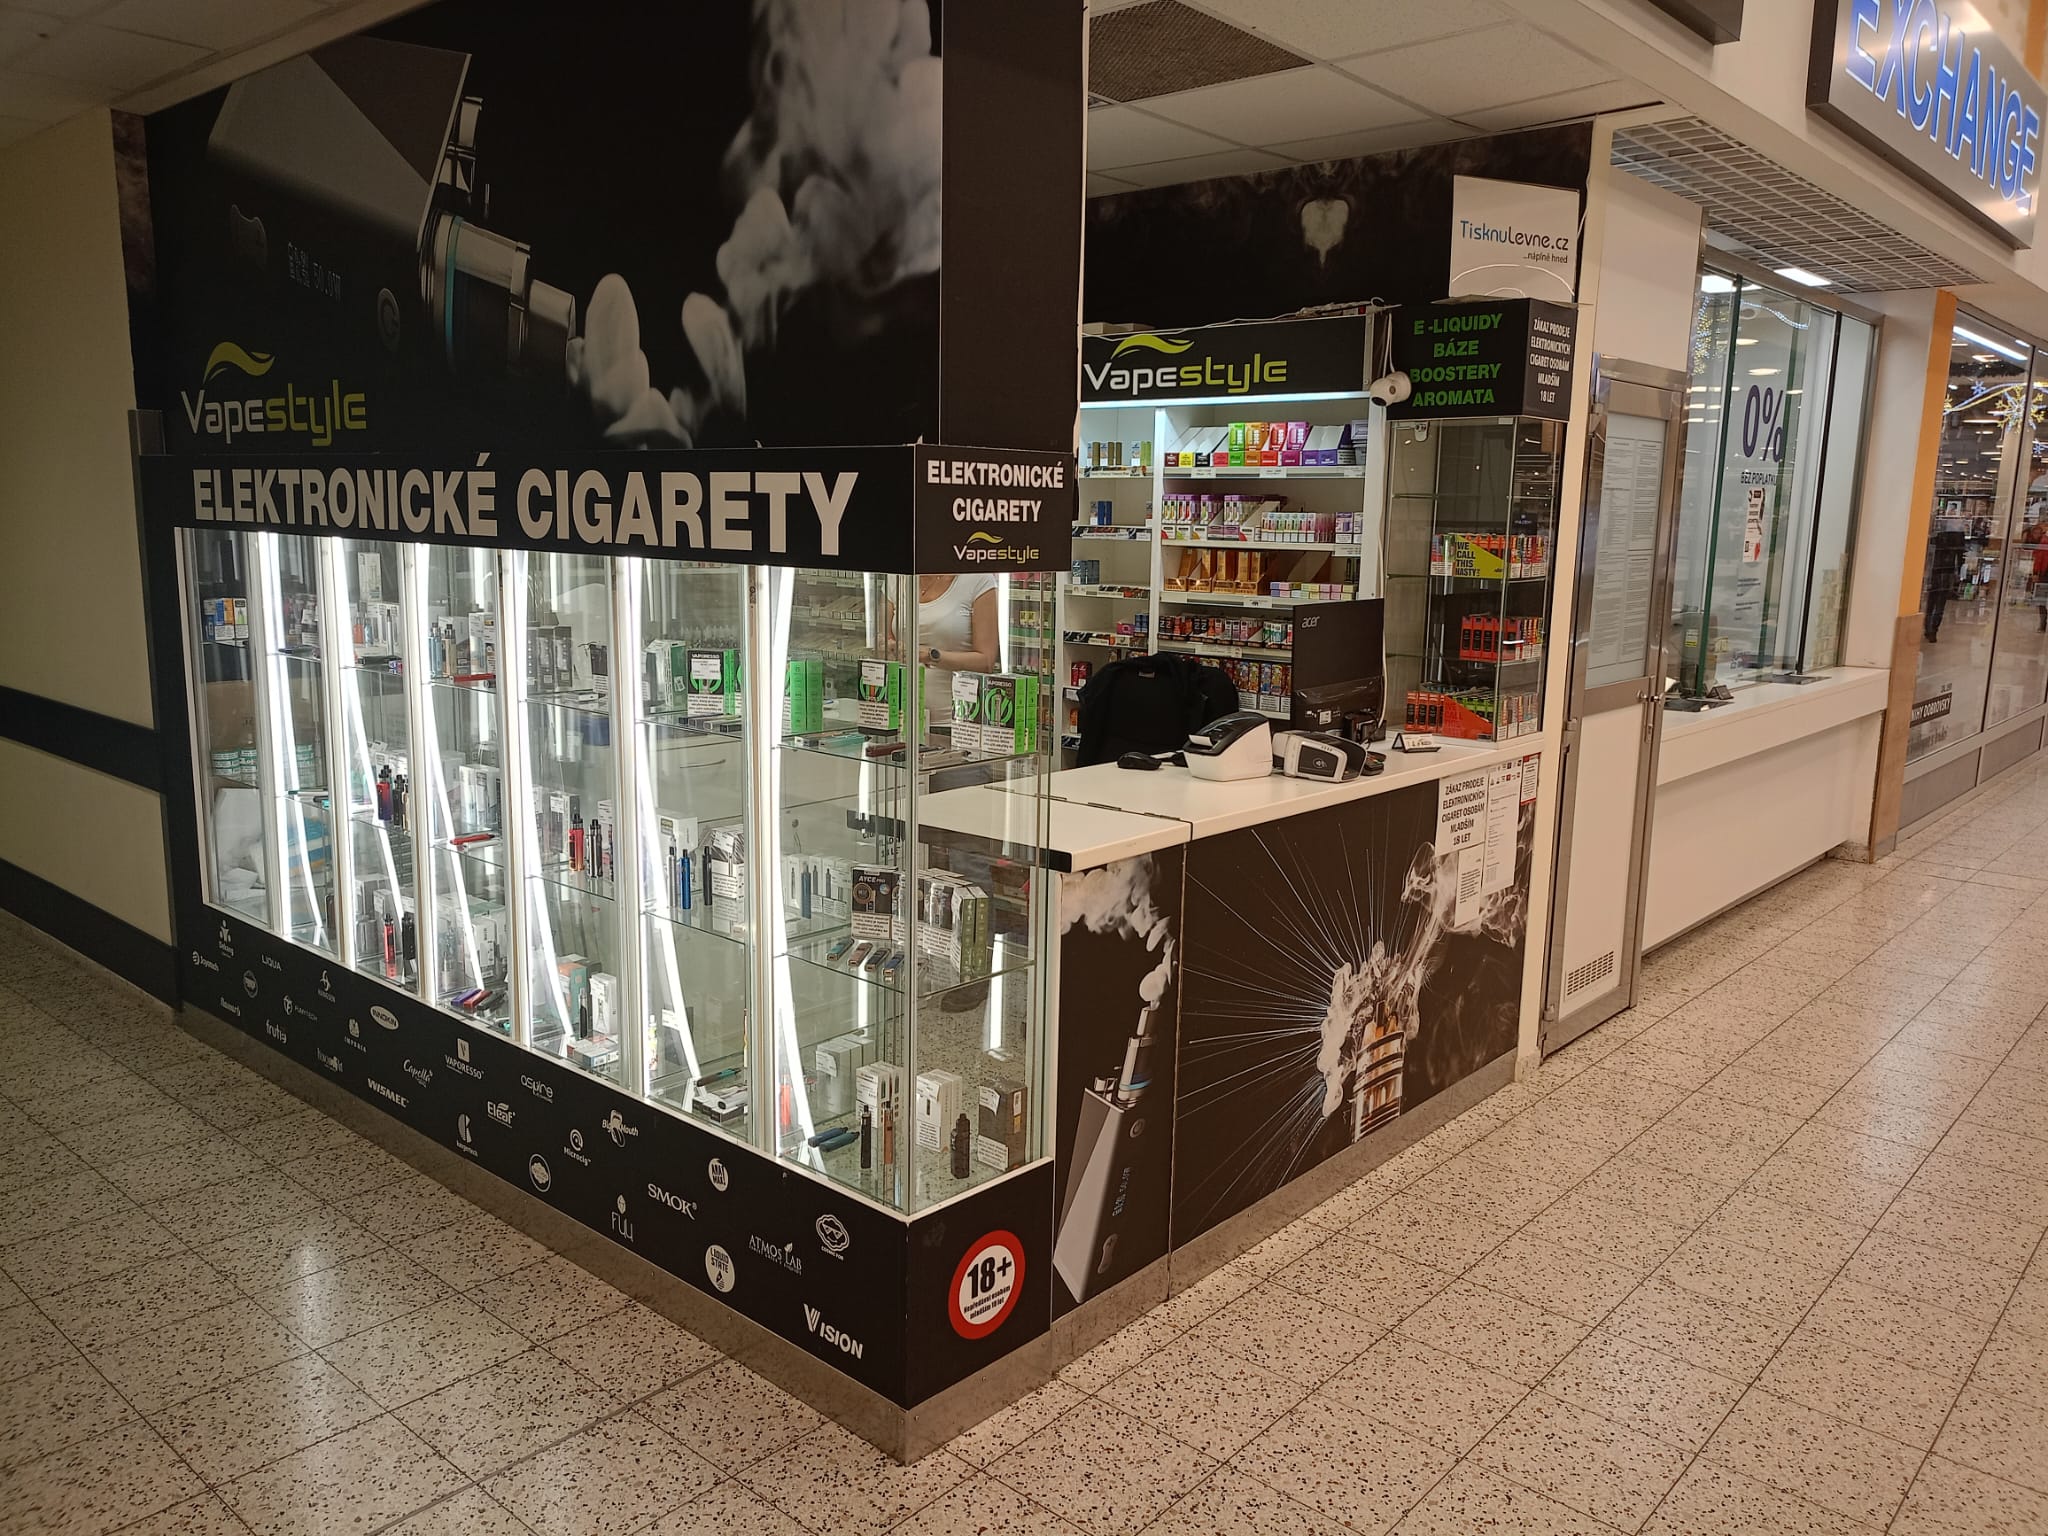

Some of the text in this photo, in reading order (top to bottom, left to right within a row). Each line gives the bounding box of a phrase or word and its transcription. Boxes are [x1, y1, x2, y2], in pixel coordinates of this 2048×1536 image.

[1845, 0, 2040, 216] EXCHANGE
[1460, 220, 1569, 251] TisknuLevne.cz
[1551, 253, 1568, 264] hned
[1550, 323, 1570, 338] PRODEJE
[1433, 338, 1479, 358] BÁZE
[1529, 353, 1570, 371] CIGARET OSOBÁM
[1083, 353, 1287, 396] Vapestyle
[1410, 363, 1502, 383] BOOSTERY
[1412, 389, 1495, 407] AROMATA
[1540, 390, 1555, 403] 18 LET
[180, 379, 367, 447] Vapestyle
[1742, 385, 1784, 463] 0%
[927, 460, 1064, 489] ELEKTRONICKÉ
[192, 452, 859, 556] ELEKTRONICKÉ CIGARETY
[952, 498, 1042, 522] CIGARETY
[953, 545, 1040, 564] Vapestyle
[1456, 551, 1476, 559] CALL
[1457, 541, 1470, 550] WE
[1301, 616, 1320, 628] acer
[1445, 777, 1485, 795] ZÁKAZ PRODEJE
[1441, 802, 1485, 823] CIGARET OSOBÁM
[1453, 833, 1471, 845] 18 LET
[261, 954, 282, 971] LIQUA
[367, 1078, 407, 1108] WISMEC
[520, 1074, 554, 1098] aspire
[749, 1234, 782, 1260] ATMOS
[785, 1251, 802, 1271] LAB
[711, 1257, 728, 1273] STATE
[967, 1256, 1012, 1300] 18+
[803, 1303, 864, 1360] VISION
